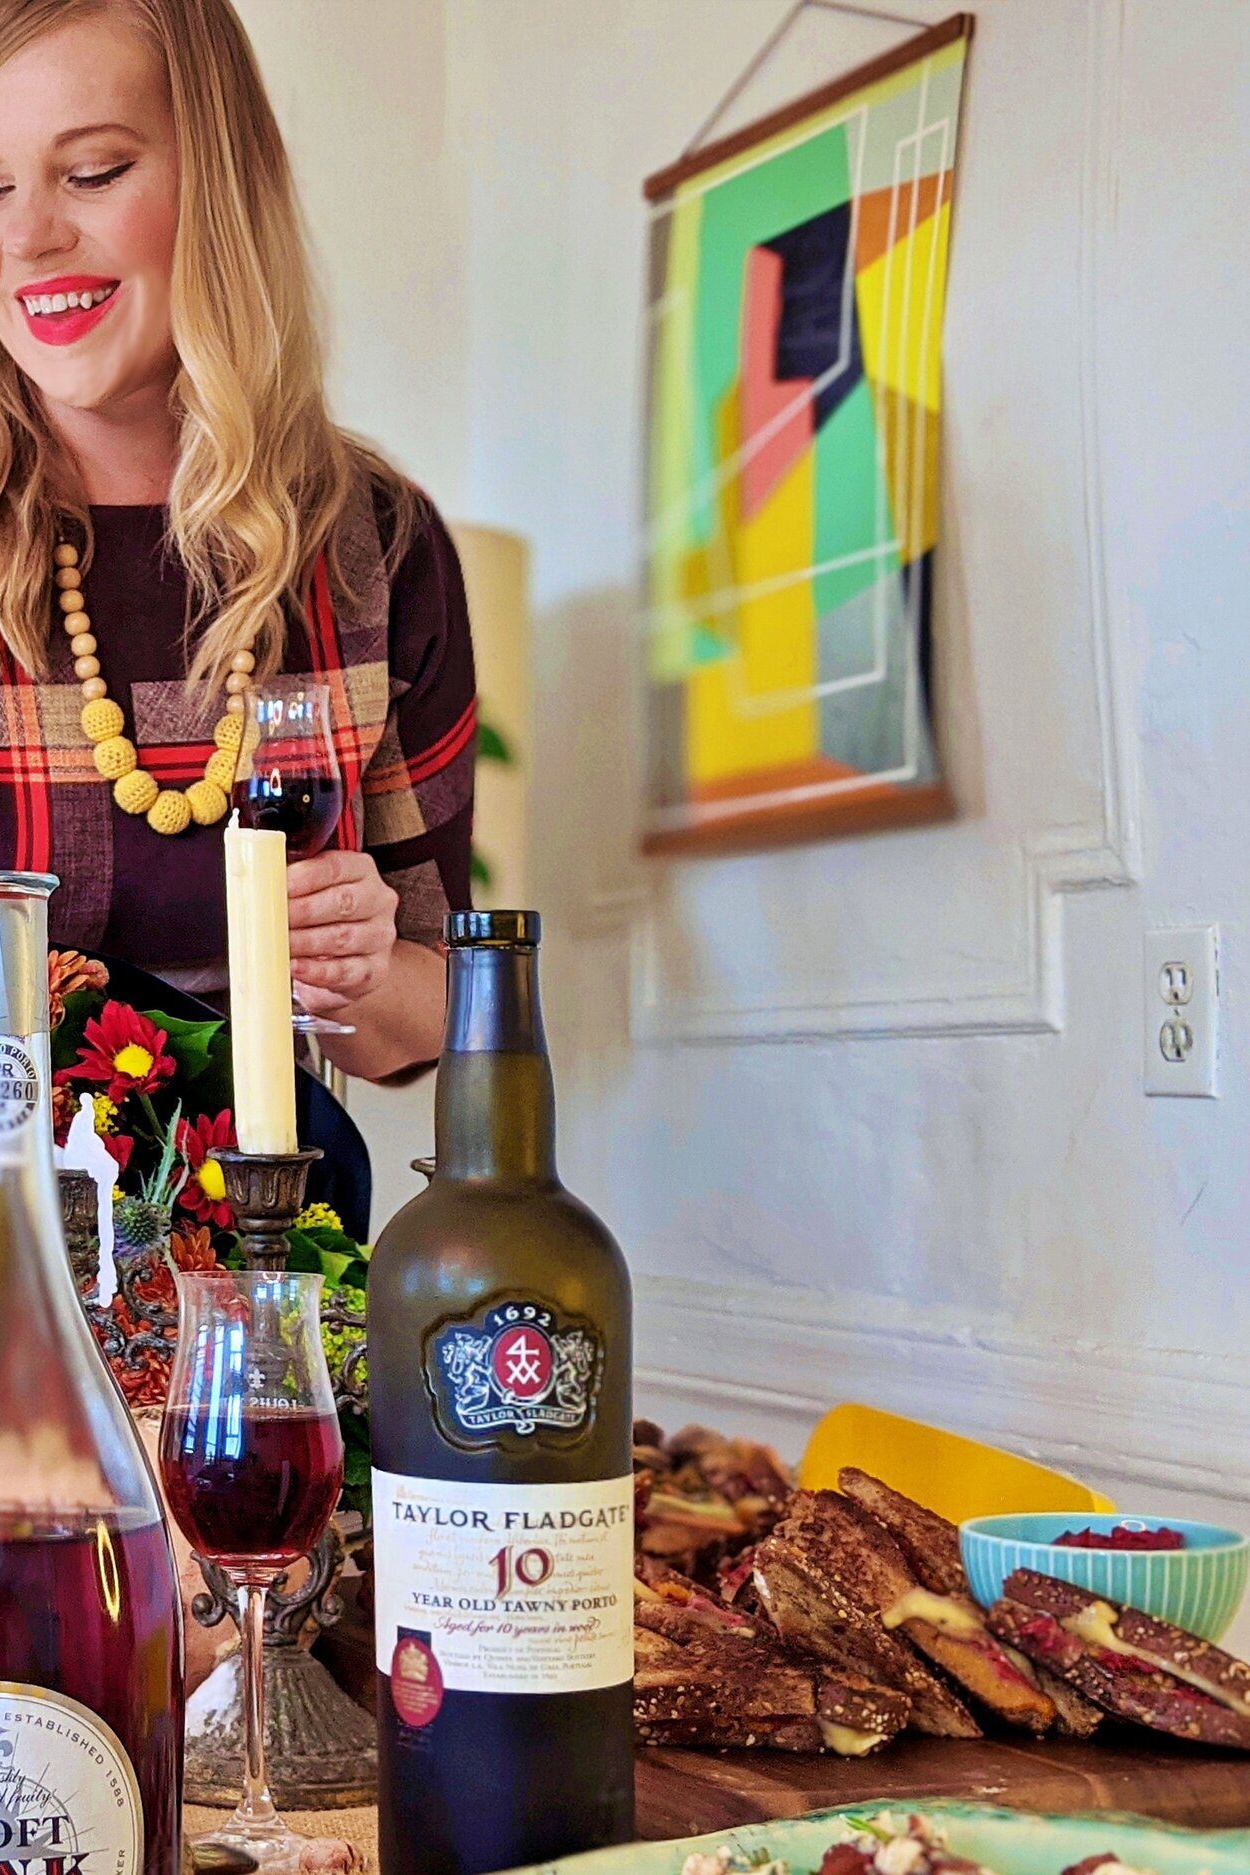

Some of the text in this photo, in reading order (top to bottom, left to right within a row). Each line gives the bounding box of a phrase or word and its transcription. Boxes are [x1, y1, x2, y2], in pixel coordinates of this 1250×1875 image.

[493, 1306, 551, 1326] 1692
[469, 1410, 515, 1424] TAYLOR
[392, 1501, 628, 1532] TAYLOR FLADGATE
[488, 1545, 555, 1599] 10
[411, 1592, 454, 1608] YEAR
[458, 1597, 497, 1611] OLD
[502, 1599, 568, 1613] TAWNY
[571, 1593, 618, 1611] PORTO
[433, 1616, 471, 1635] Aged
[469, 1619, 494, 1637] for
[495, 1622, 512, 1634] 10
[512, 1623, 550, 1638] years
[4, 1712, 125, 1807] ESTABLISHED 1588
